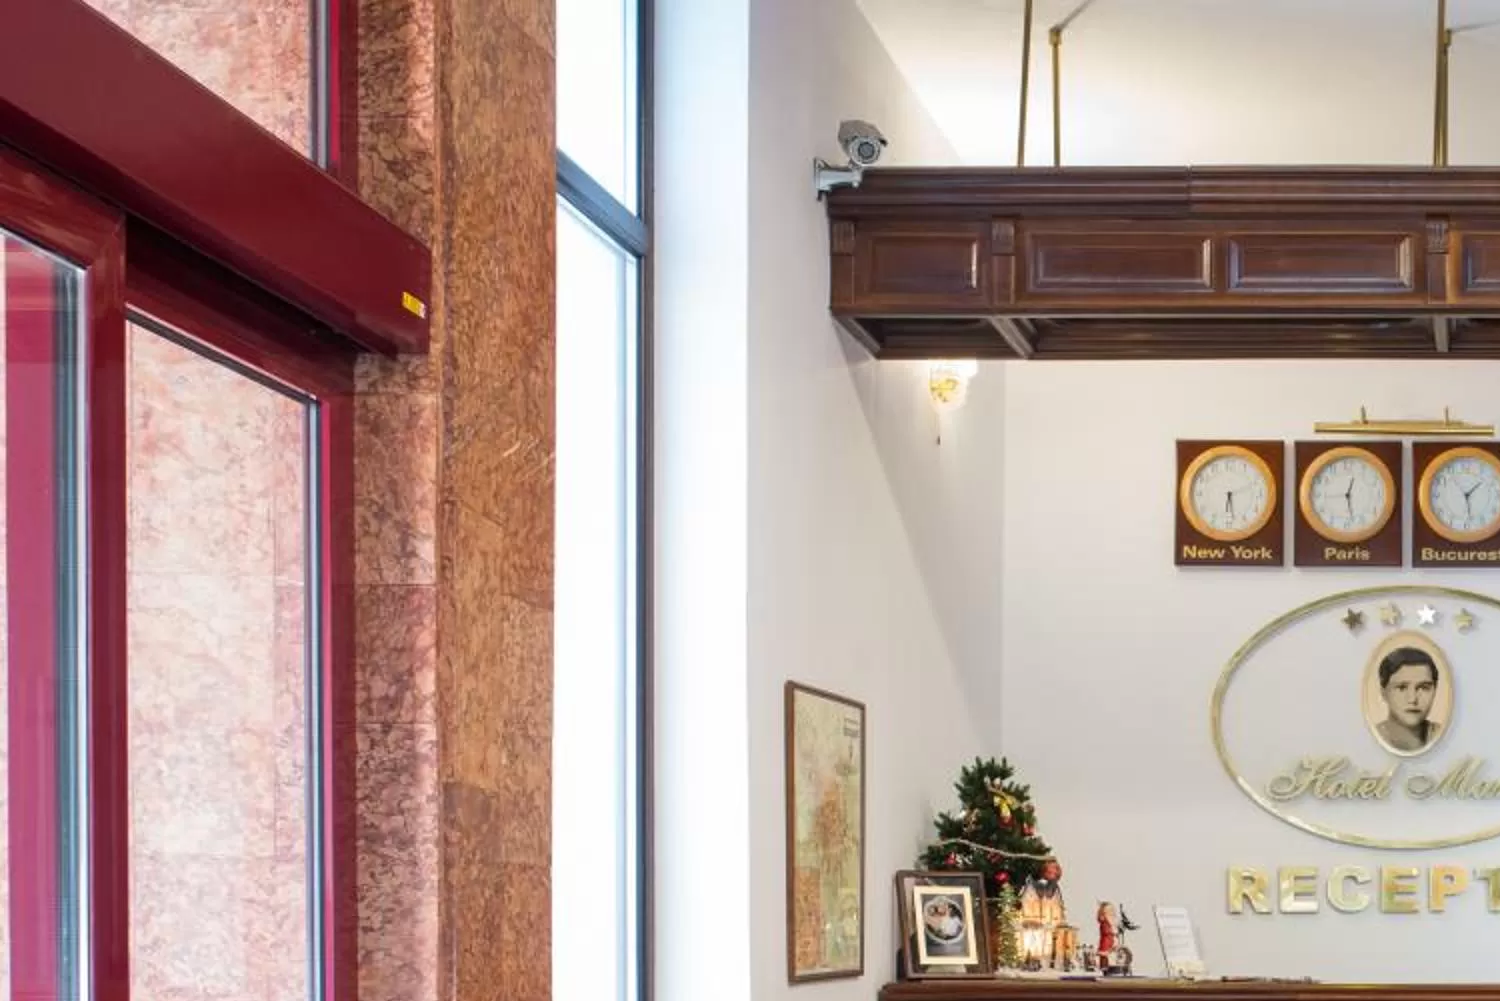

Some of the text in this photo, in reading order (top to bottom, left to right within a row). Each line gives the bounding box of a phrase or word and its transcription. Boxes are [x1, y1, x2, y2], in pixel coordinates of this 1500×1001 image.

[1182, 545, 1273, 559] New York
[1323, 546, 1370, 561] Paris
[1266, 755, 1399, 801] Hotel
